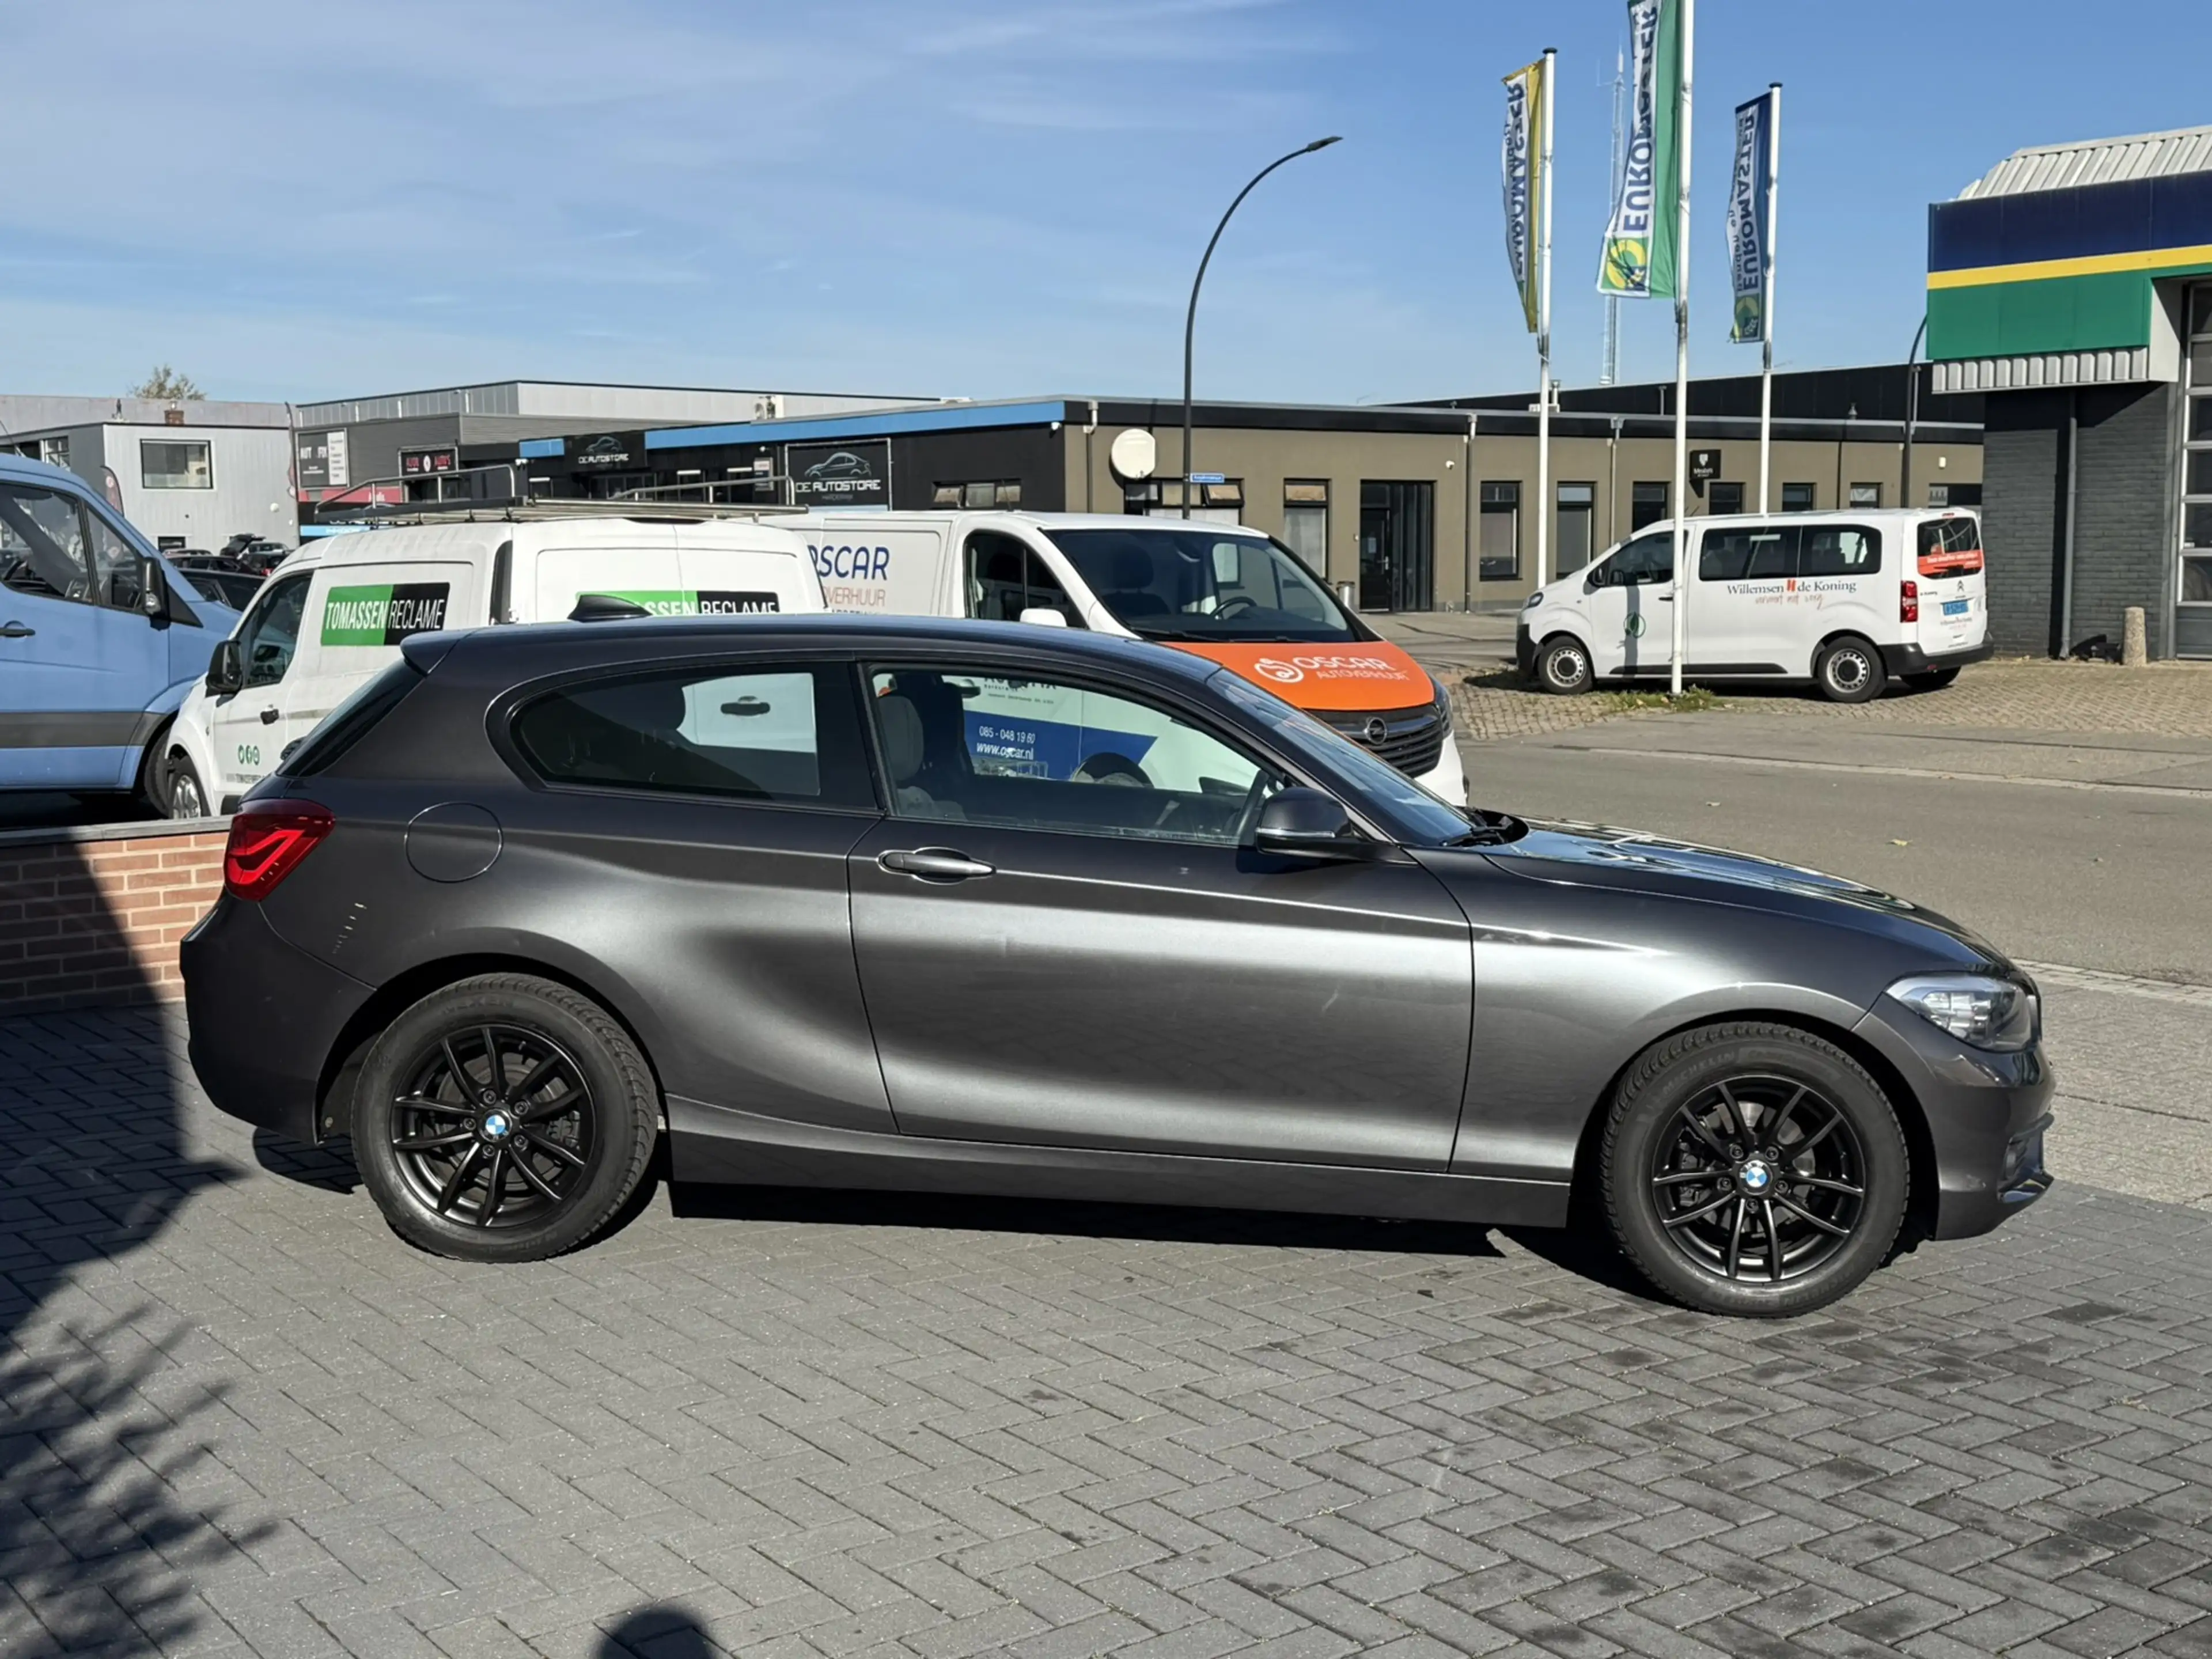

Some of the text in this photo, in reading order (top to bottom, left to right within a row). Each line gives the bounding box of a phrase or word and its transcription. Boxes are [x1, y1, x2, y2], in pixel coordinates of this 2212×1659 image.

[588, 453, 629, 463] AUTOSTORE
[796, 479, 881, 493] DE AUTOSTORE
[1727, 581, 1857, 594] Willemsen de Koning
[824, 586, 886, 607] VERHUUR
[325, 599, 445, 630] TOMASSEN RECLAME
[1293, 656, 1398, 671] OSCAR
[979, 726, 994, 738] 085
[1000, 728, 1014, 741] 048
[1017, 732, 1025, 744] 19
[976, 741, 1035, 761] www.oscar.nl
